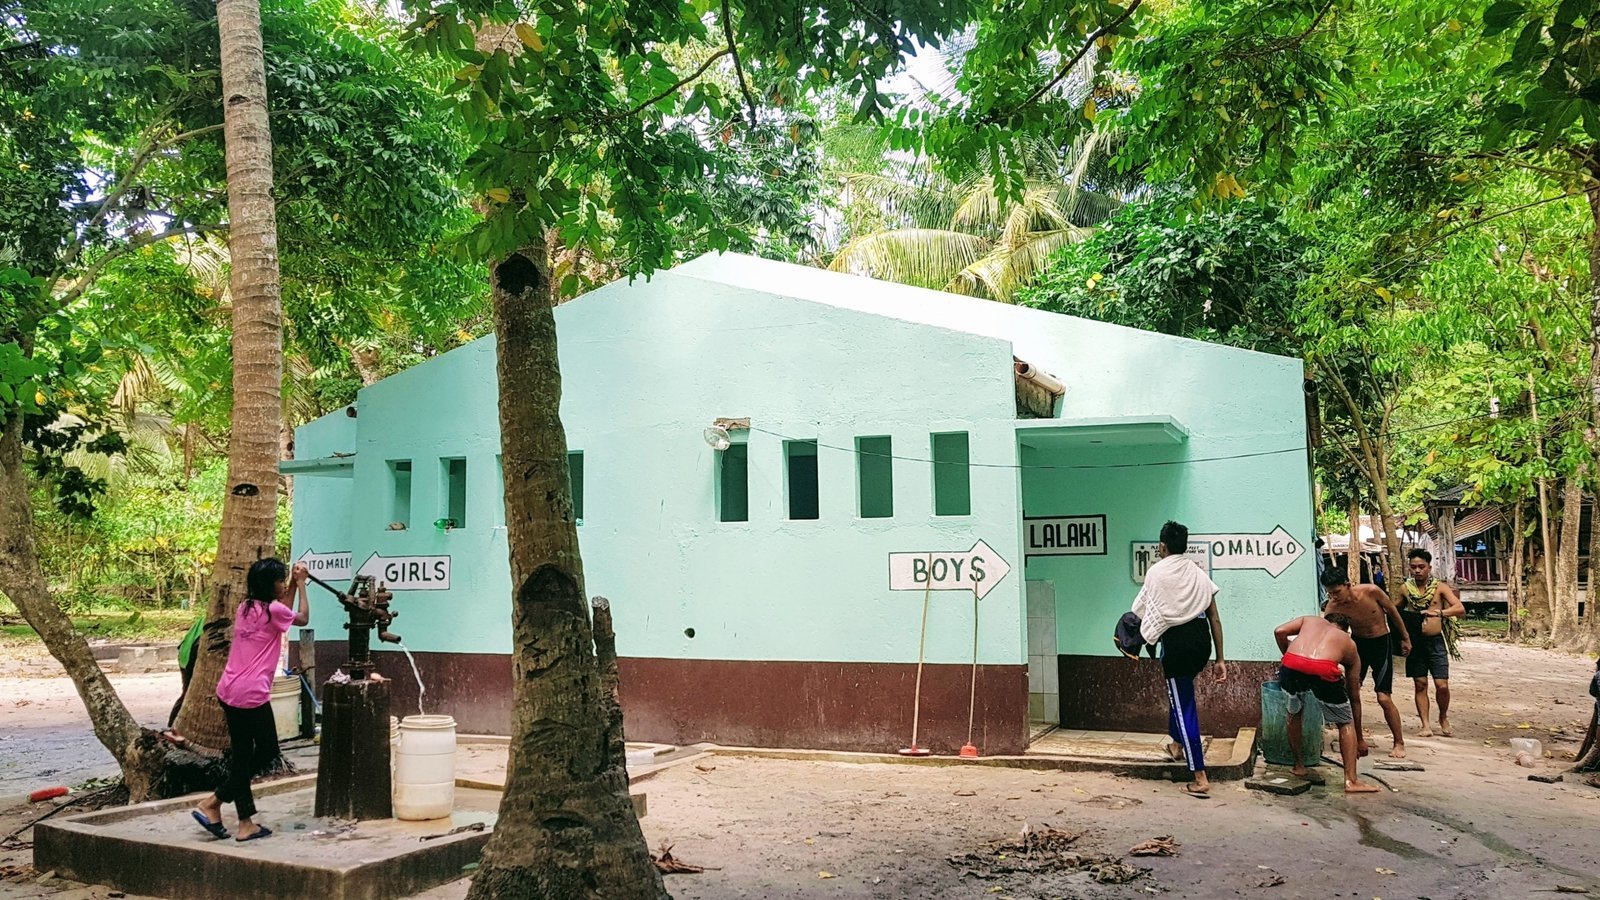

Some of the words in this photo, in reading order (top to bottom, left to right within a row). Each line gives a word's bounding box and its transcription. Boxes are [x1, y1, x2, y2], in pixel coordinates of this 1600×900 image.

[1029, 522, 1097, 548] LALAKI
[384, 561, 446, 583] GIRLS
[913, 556, 986, 582] BOYS
